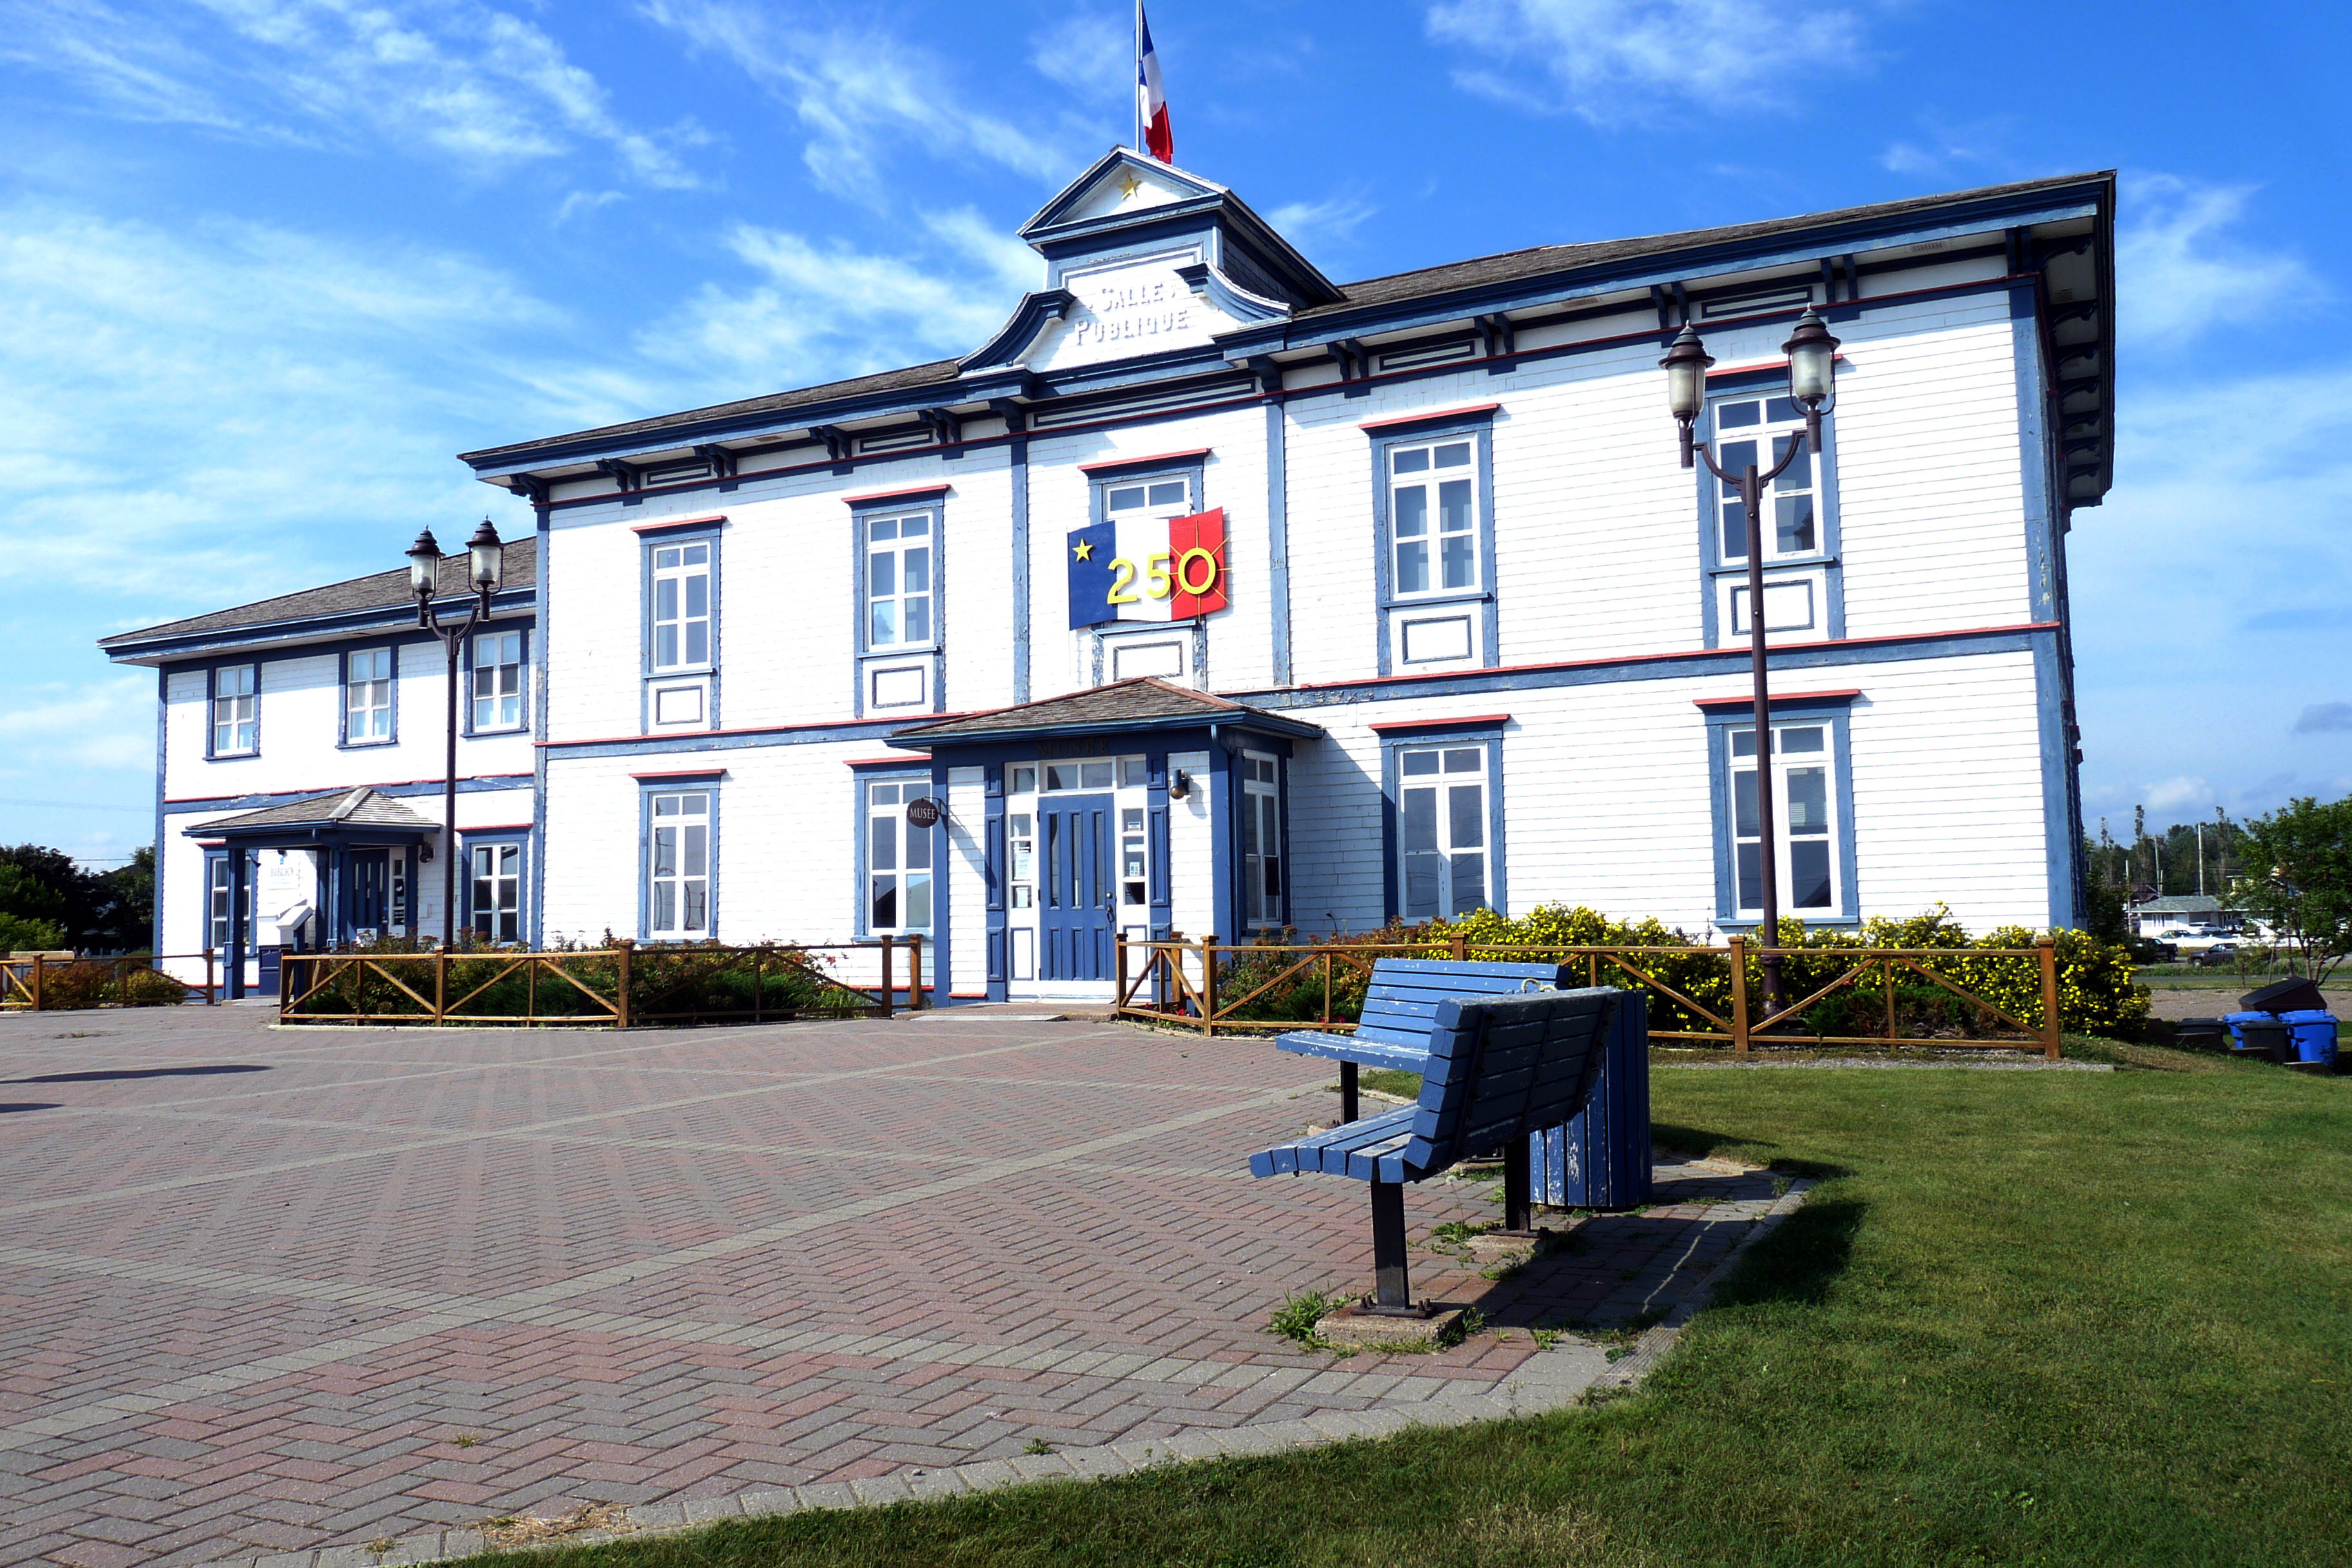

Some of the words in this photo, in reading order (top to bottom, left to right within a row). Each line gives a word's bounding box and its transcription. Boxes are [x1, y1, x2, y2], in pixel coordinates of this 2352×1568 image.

[1100, 282, 1164, 312] SALLE
[1075, 309, 1188, 346] PUBLIQUE
[1107, 547, 1216, 604] 250
